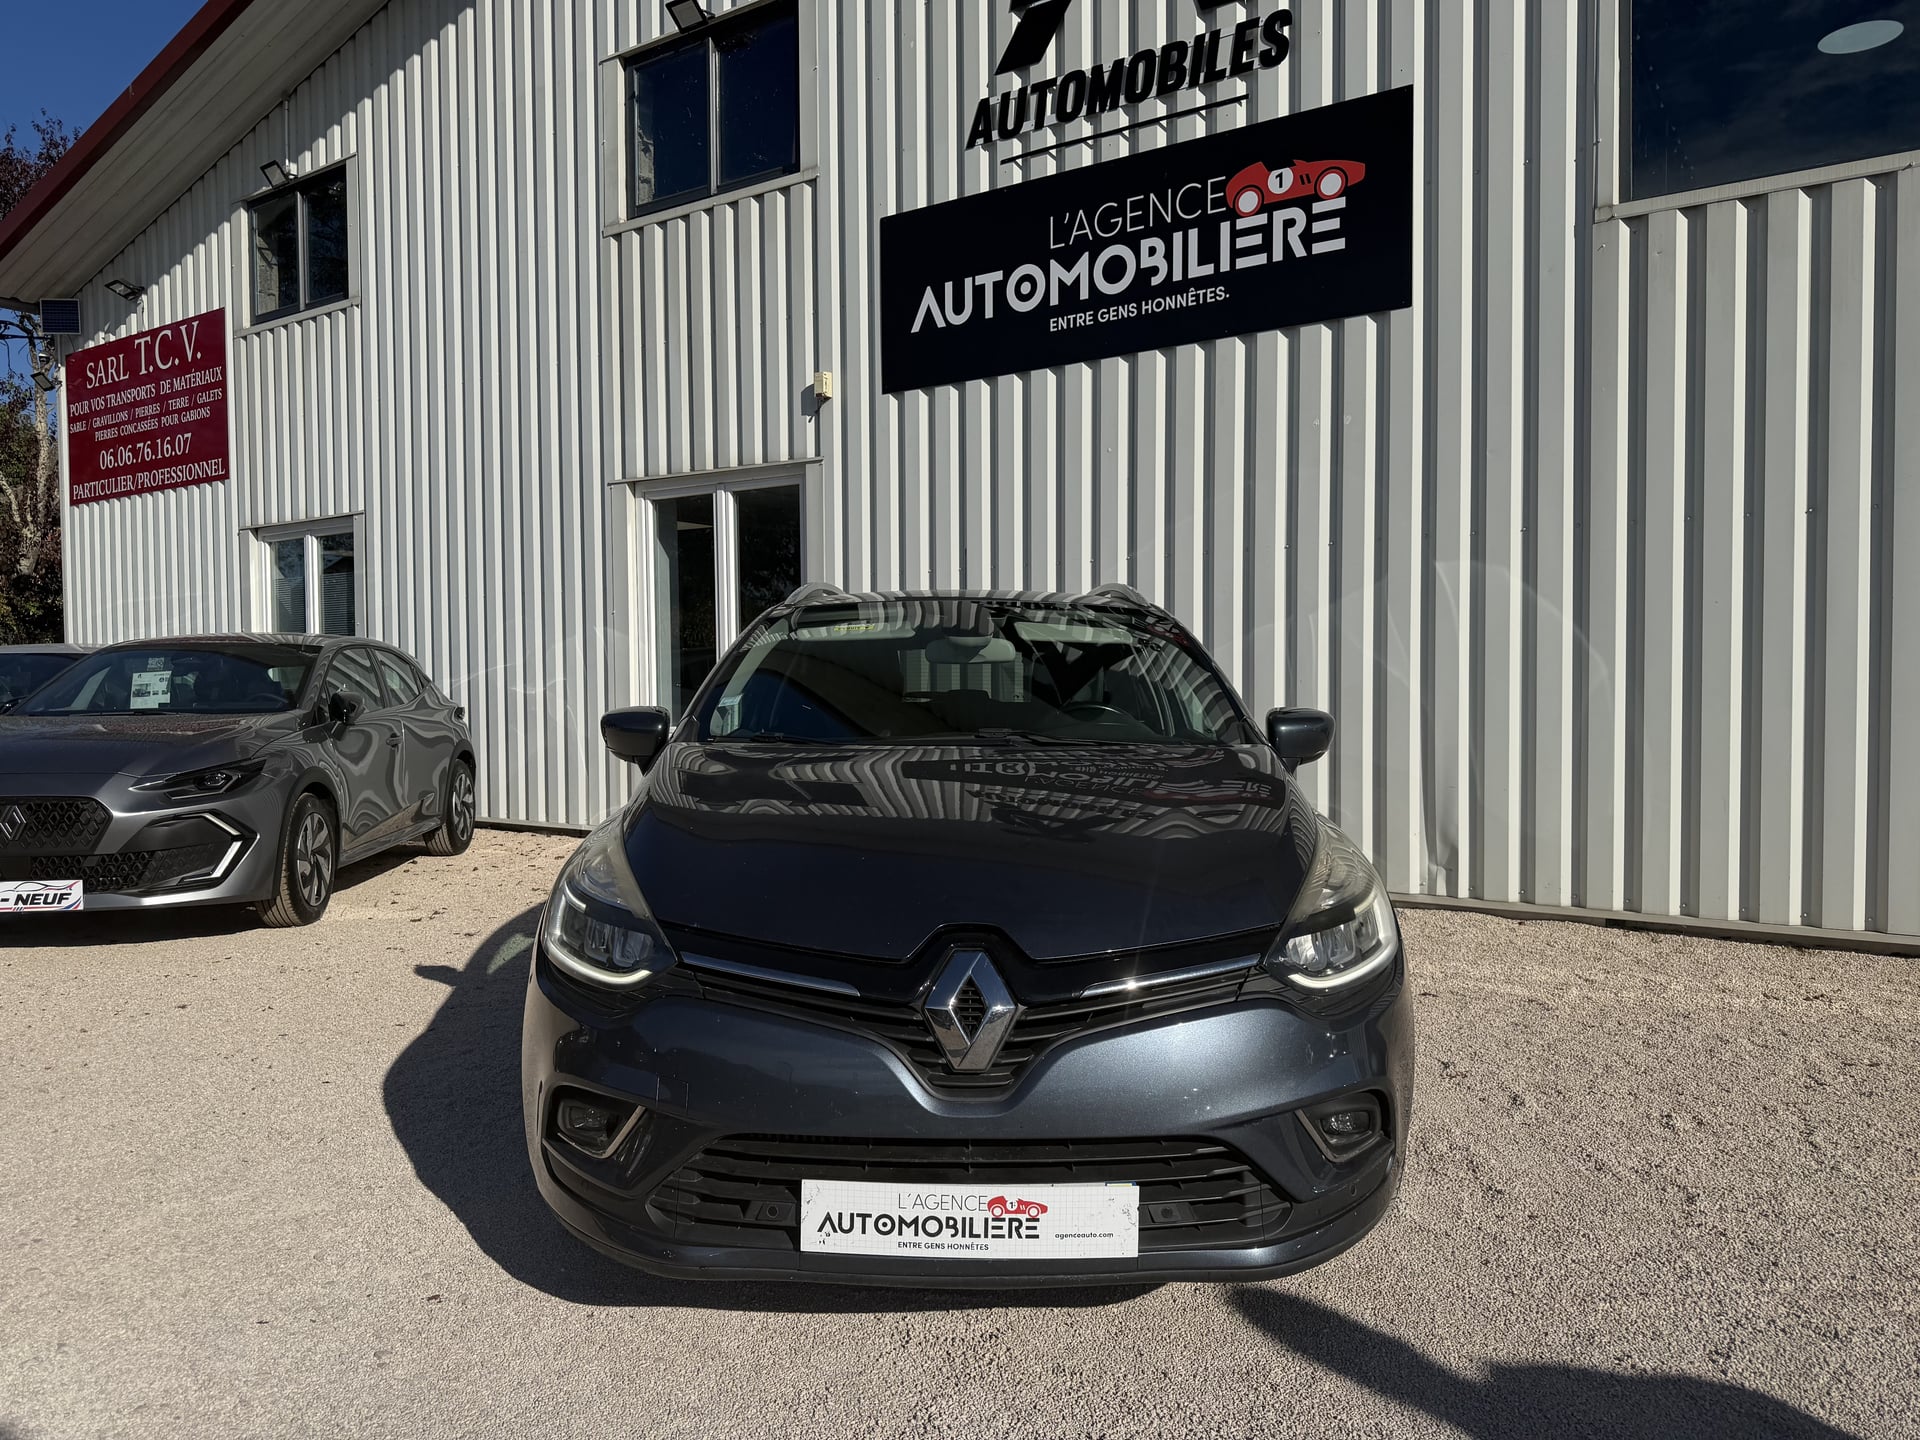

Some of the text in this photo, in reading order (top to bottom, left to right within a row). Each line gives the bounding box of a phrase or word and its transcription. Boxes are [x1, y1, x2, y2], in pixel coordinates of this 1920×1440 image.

[965, 9, 1293, 151] AUTOMOBILES
[1049, 176, 1227, 250] L'AGENCE
[1049, 287, 1230, 333] ENTRE GENS HONNÊTES.
[86, 320, 201, 389] SARL T.C.V.
[69, 366, 223, 417] POUR VOS TRANSPORTS DE MATÉRIAUX
[69, 419, 87, 434] SABLE
[92, 409, 129, 429] GRAVILLONS
[135, 402, 160, 418] PIERRES
[168, 395, 189, 411] TERRE
[196, 388, 223, 404] GALETS
[94, 406, 211, 442] PIERRES CONCASSÉES POUR GABIONS
[99, 432, 192, 470] 06.06.76.16.07
[72, 457, 226, 500] PARTICULIER/PROFESSIONNEL
[14, 893, 72, 905] NEUF
[898, 1192, 988, 1212] L'AGENCE
[897, 1240, 989, 1252] ENTRE GENS HONNÊTES
[1054, 1231, 1114, 1240] agenceauto.com
